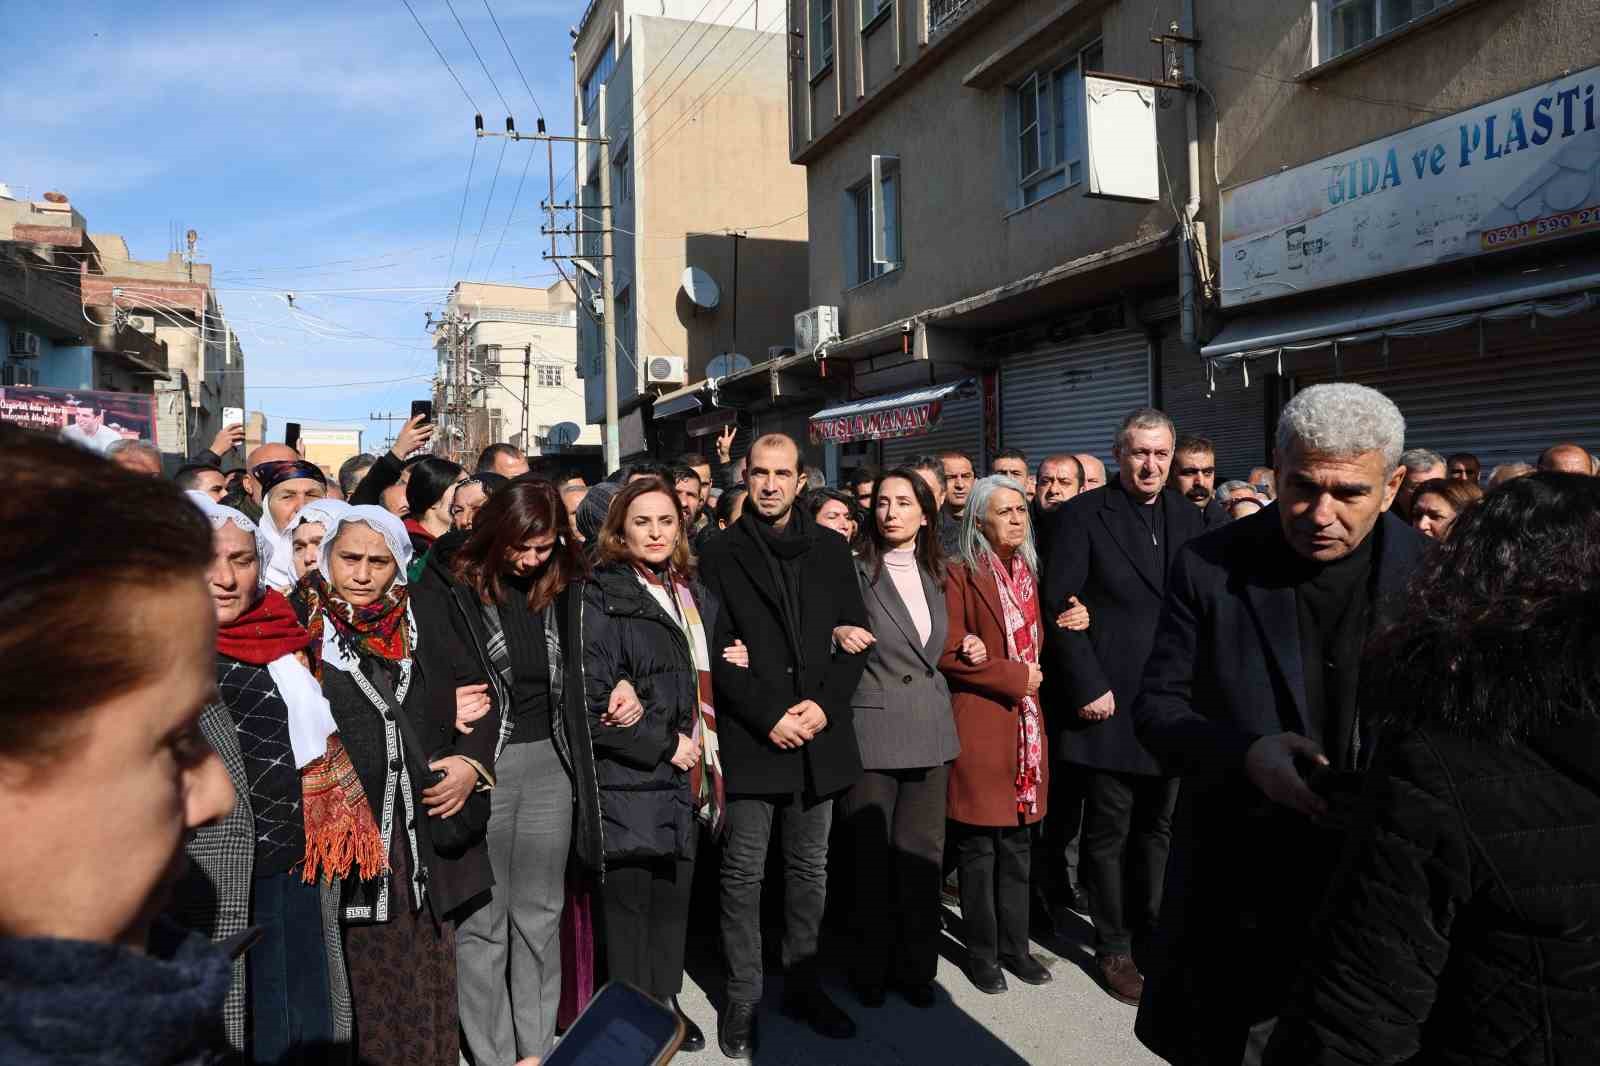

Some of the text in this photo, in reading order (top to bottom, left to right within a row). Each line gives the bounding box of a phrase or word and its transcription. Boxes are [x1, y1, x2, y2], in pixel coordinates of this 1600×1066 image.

[1327, 147, 1401, 205] GIDA
[1411, 143, 1446, 180] ve
[867, 403, 930, 434] MANAV
